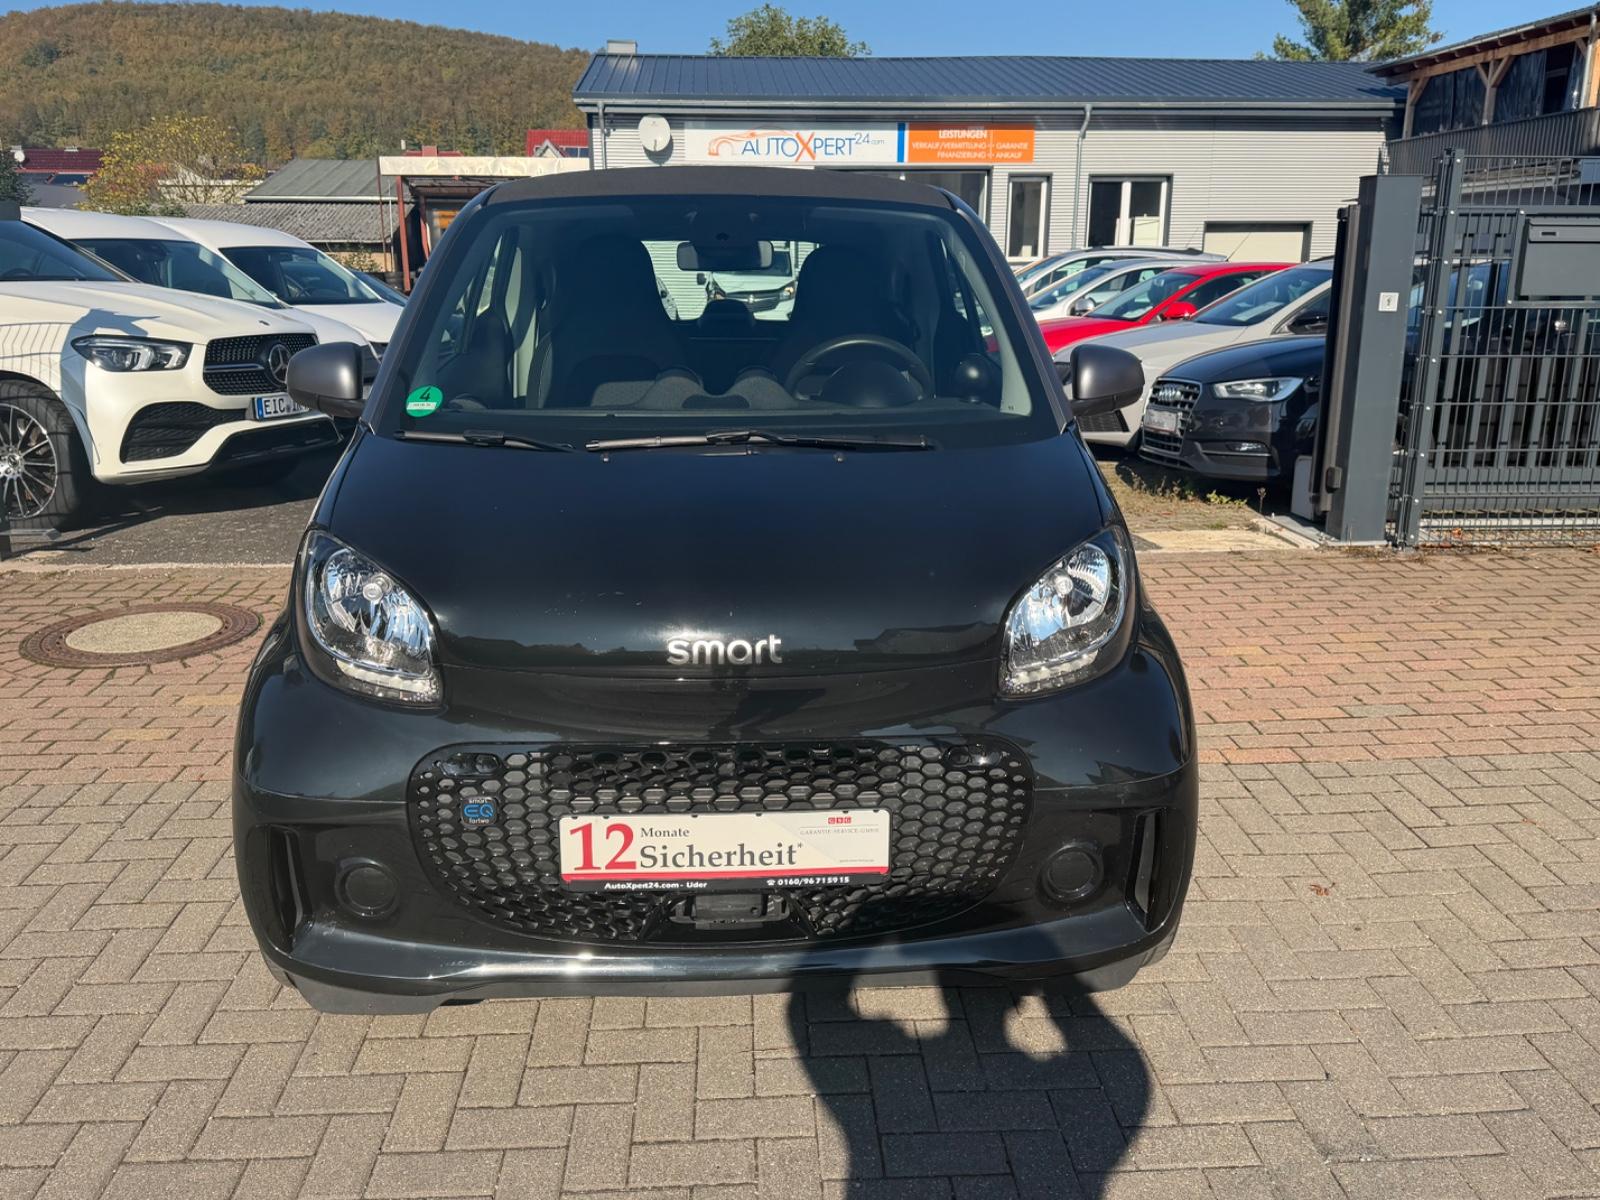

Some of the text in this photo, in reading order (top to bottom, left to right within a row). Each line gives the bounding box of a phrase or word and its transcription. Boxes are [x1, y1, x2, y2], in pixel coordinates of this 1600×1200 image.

[939, 128, 988, 139] LEISTUNGEN
[419, 387, 431, 401] 4
[264, 398, 286, 415] EIC
[667, 634, 783, 665] smart
[640, 827, 690, 838] Monate
[569, 822, 637, 871] 12
[604, 881, 679, 890] AutoXpert24.com
